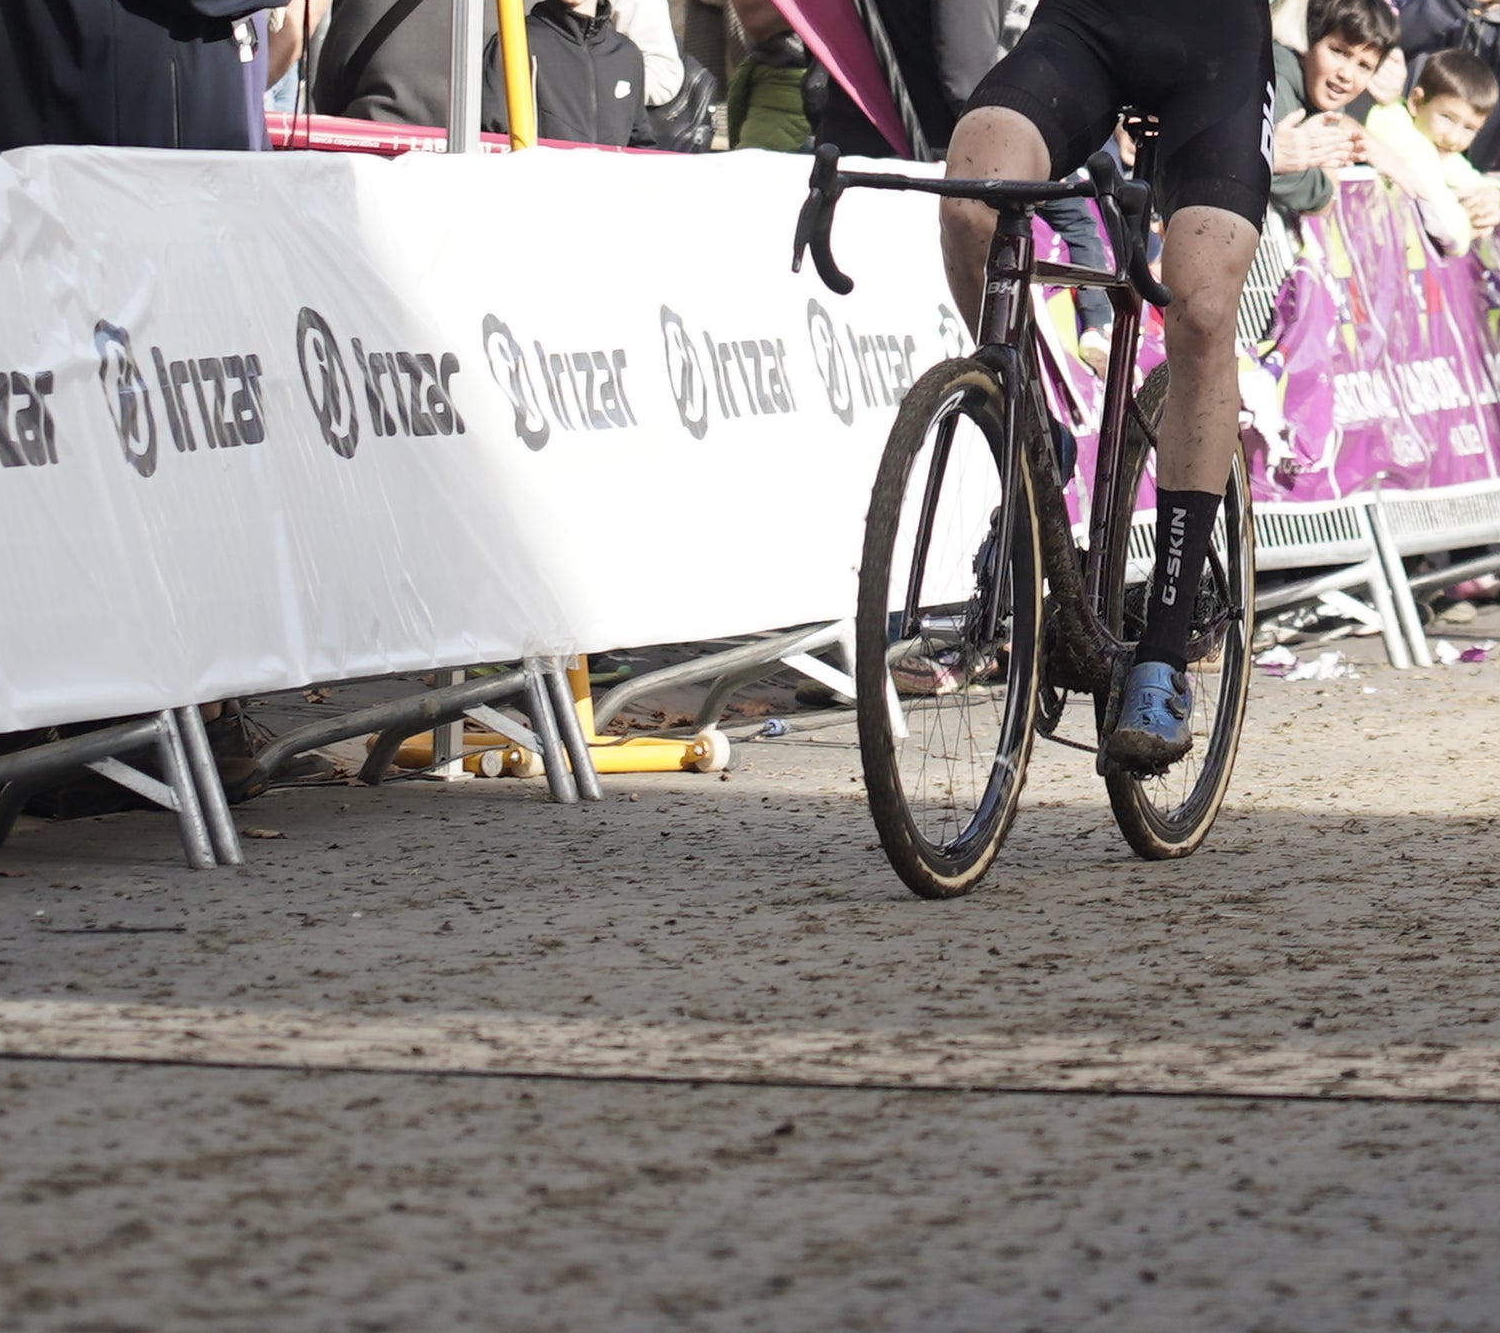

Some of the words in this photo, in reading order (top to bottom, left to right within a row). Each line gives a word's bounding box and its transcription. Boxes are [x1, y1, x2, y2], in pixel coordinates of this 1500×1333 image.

[150, 344, 266, 453] Irizar
[351, 336, 467, 438] Irizar
[534, 339, 639, 432] Irizar
[703, 329, 799, 421] Irizar
[1160, 506, 1188, 607] G-SKIN
